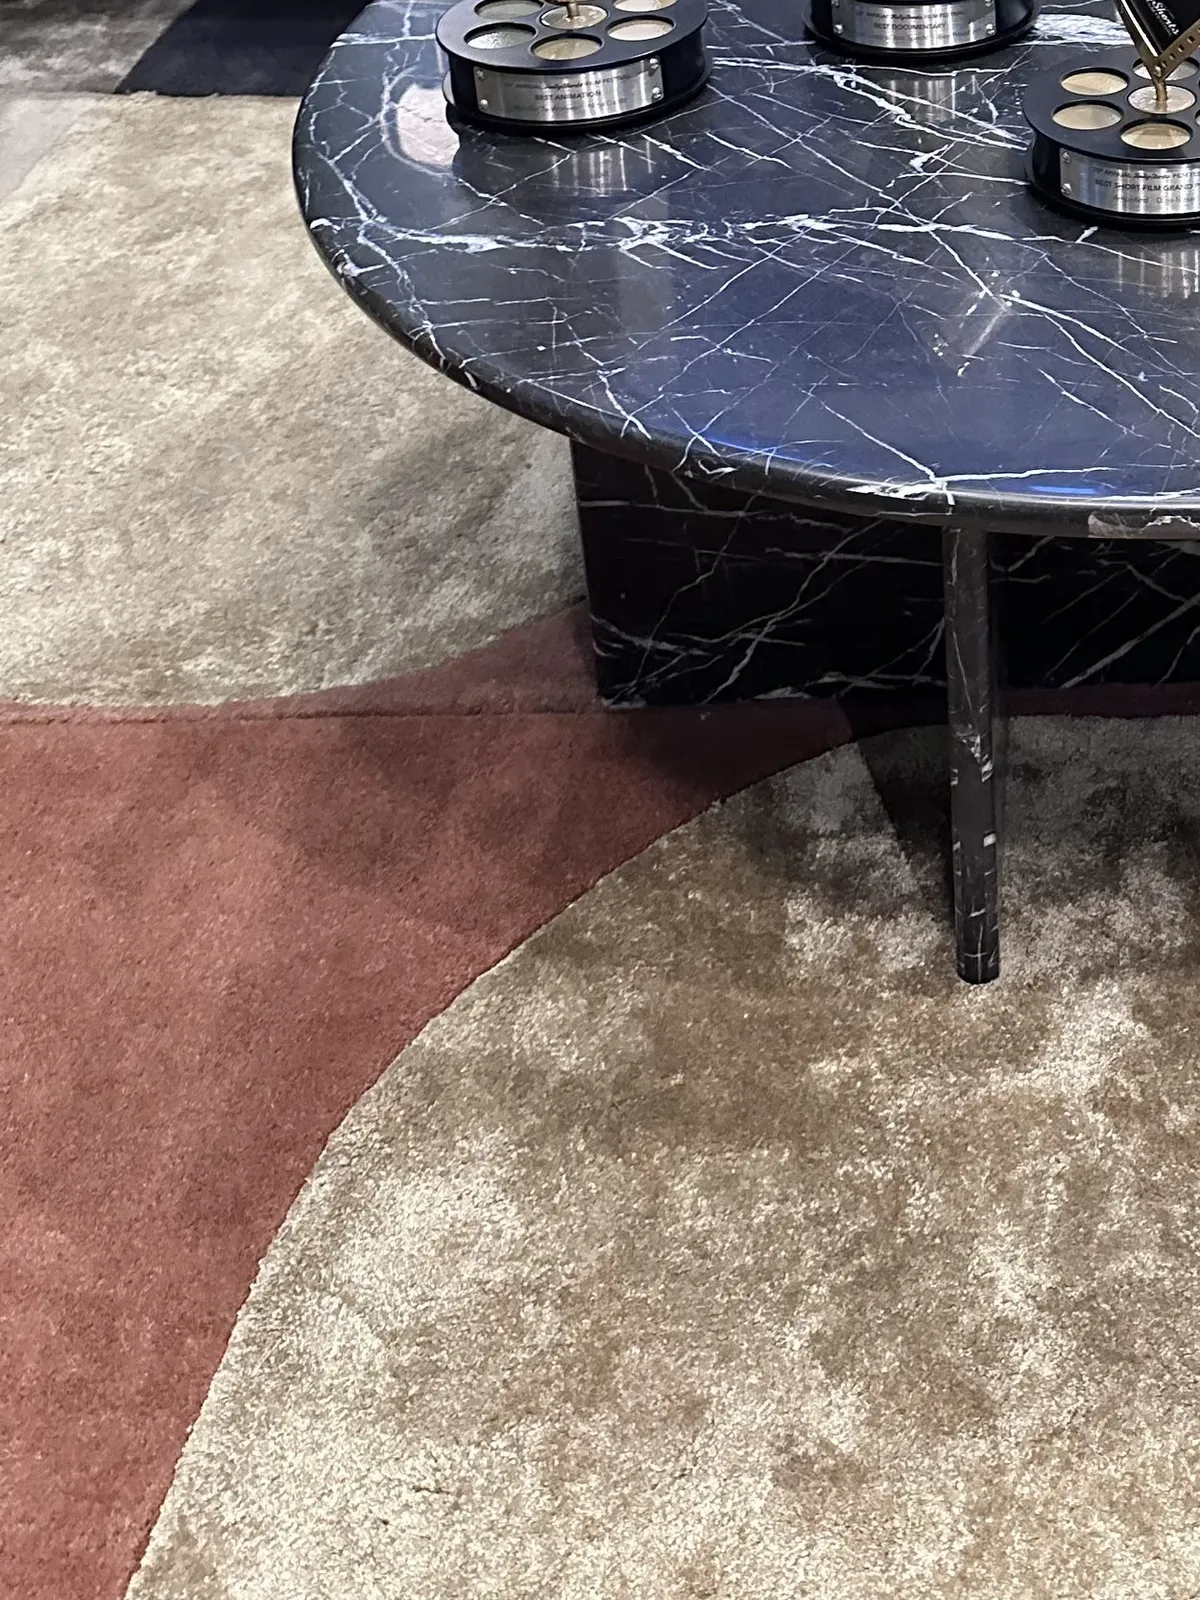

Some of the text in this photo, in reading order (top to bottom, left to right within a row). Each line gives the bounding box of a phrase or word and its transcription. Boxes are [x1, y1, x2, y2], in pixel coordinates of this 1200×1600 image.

[1094, 178, 1112, 189] BEST
[1115, 182, 1141, 192] SHORT
[1142, 184, 1163, 192] FILM
[1163, 182, 1193, 192] GRAND
